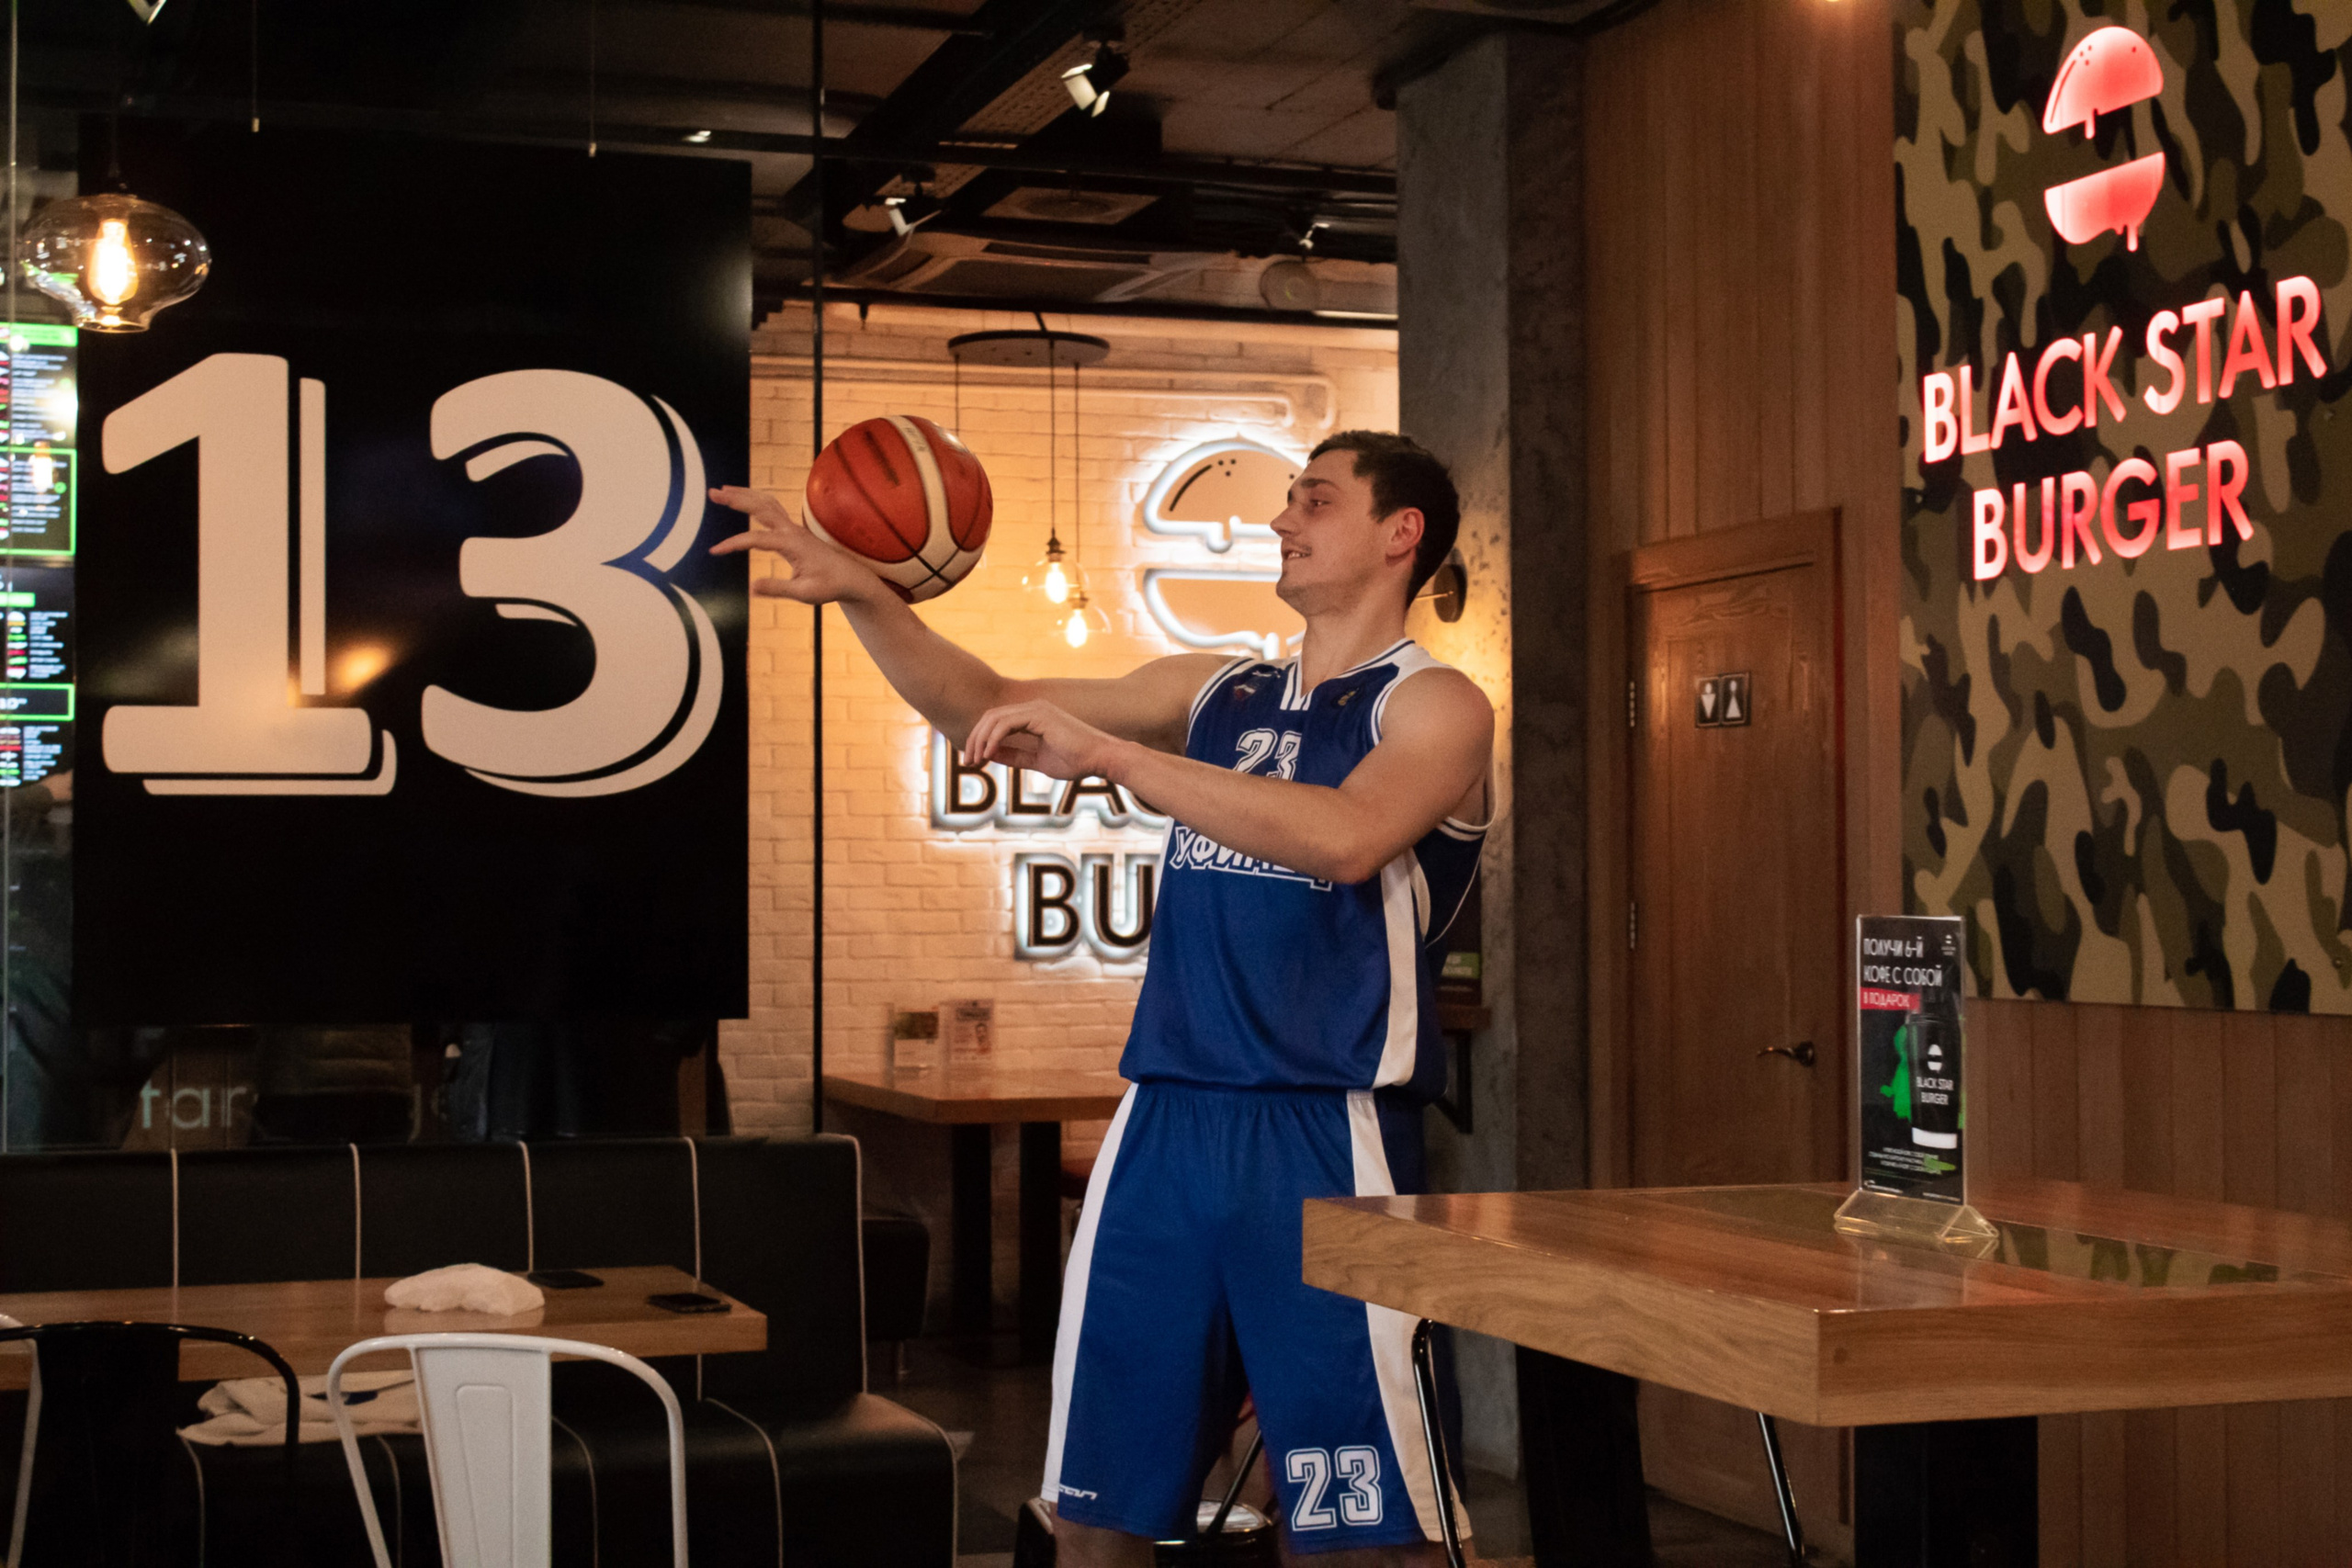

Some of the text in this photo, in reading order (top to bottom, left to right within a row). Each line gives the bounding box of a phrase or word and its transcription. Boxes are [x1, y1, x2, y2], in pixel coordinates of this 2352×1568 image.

[1924, 275, 2328, 464] BLACK STAR
[1973, 439, 2254, 581] BURGER
[102, 352, 724, 798] 13
[1863, 938, 1903, 956] ПОЛУЧИ
[1863, 964, 1942, 987] КОФЕ С СОБОЙ
[1869, 992, 1910, 1008] ПОДАРОК
[1917, 1077, 1954, 1090] BLACK STAR
[1921, 1091, 1949, 1105] BURGER
[1285, 1445, 1383, 1531] 23
